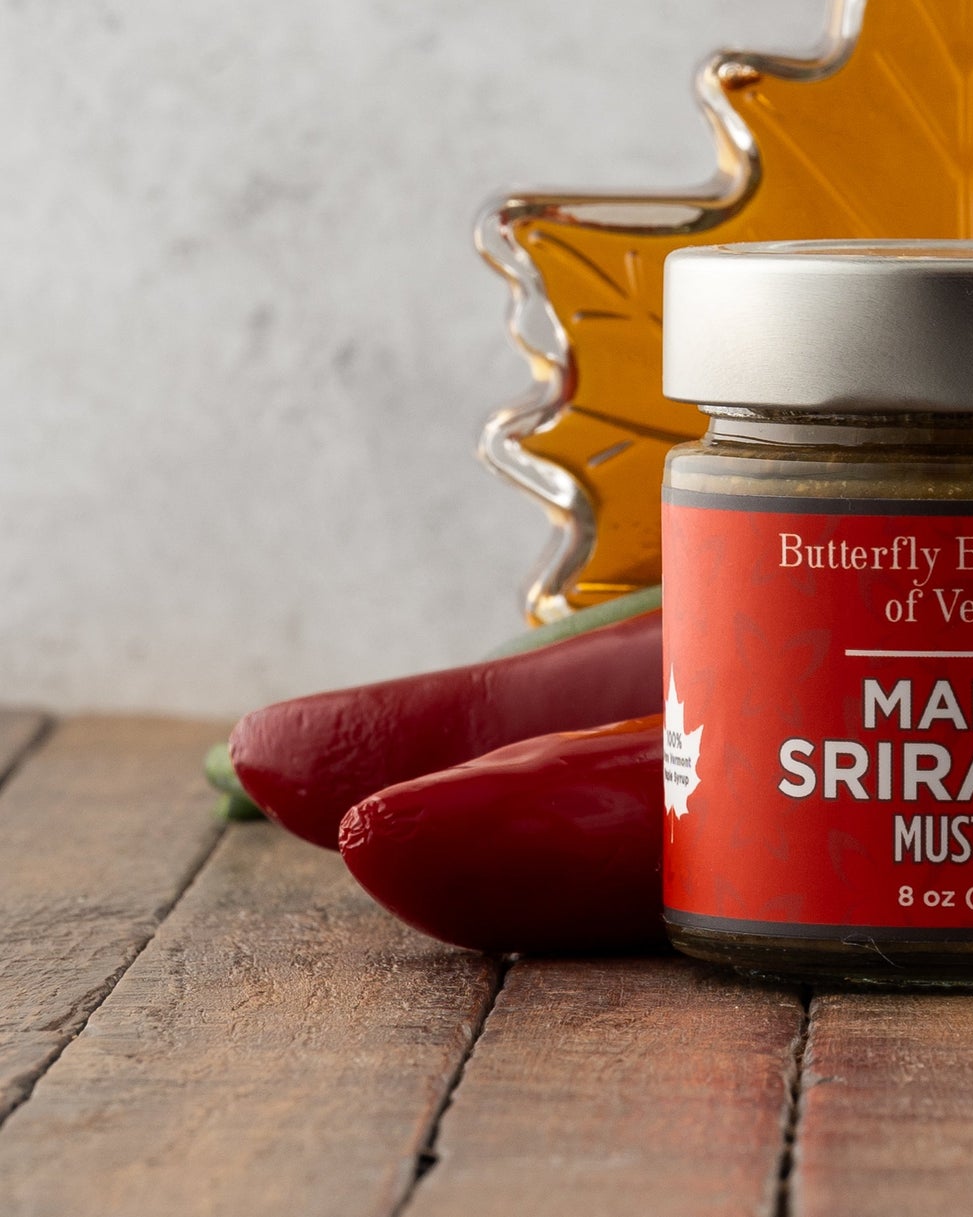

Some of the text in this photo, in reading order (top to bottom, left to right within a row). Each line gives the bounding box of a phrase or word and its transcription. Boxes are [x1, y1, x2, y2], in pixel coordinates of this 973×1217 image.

[779, 533, 941, 586] Butterfly
[885, 588, 923, 623] of
[898, 886, 914, 907] 8
[923, 889, 956, 907] oz
